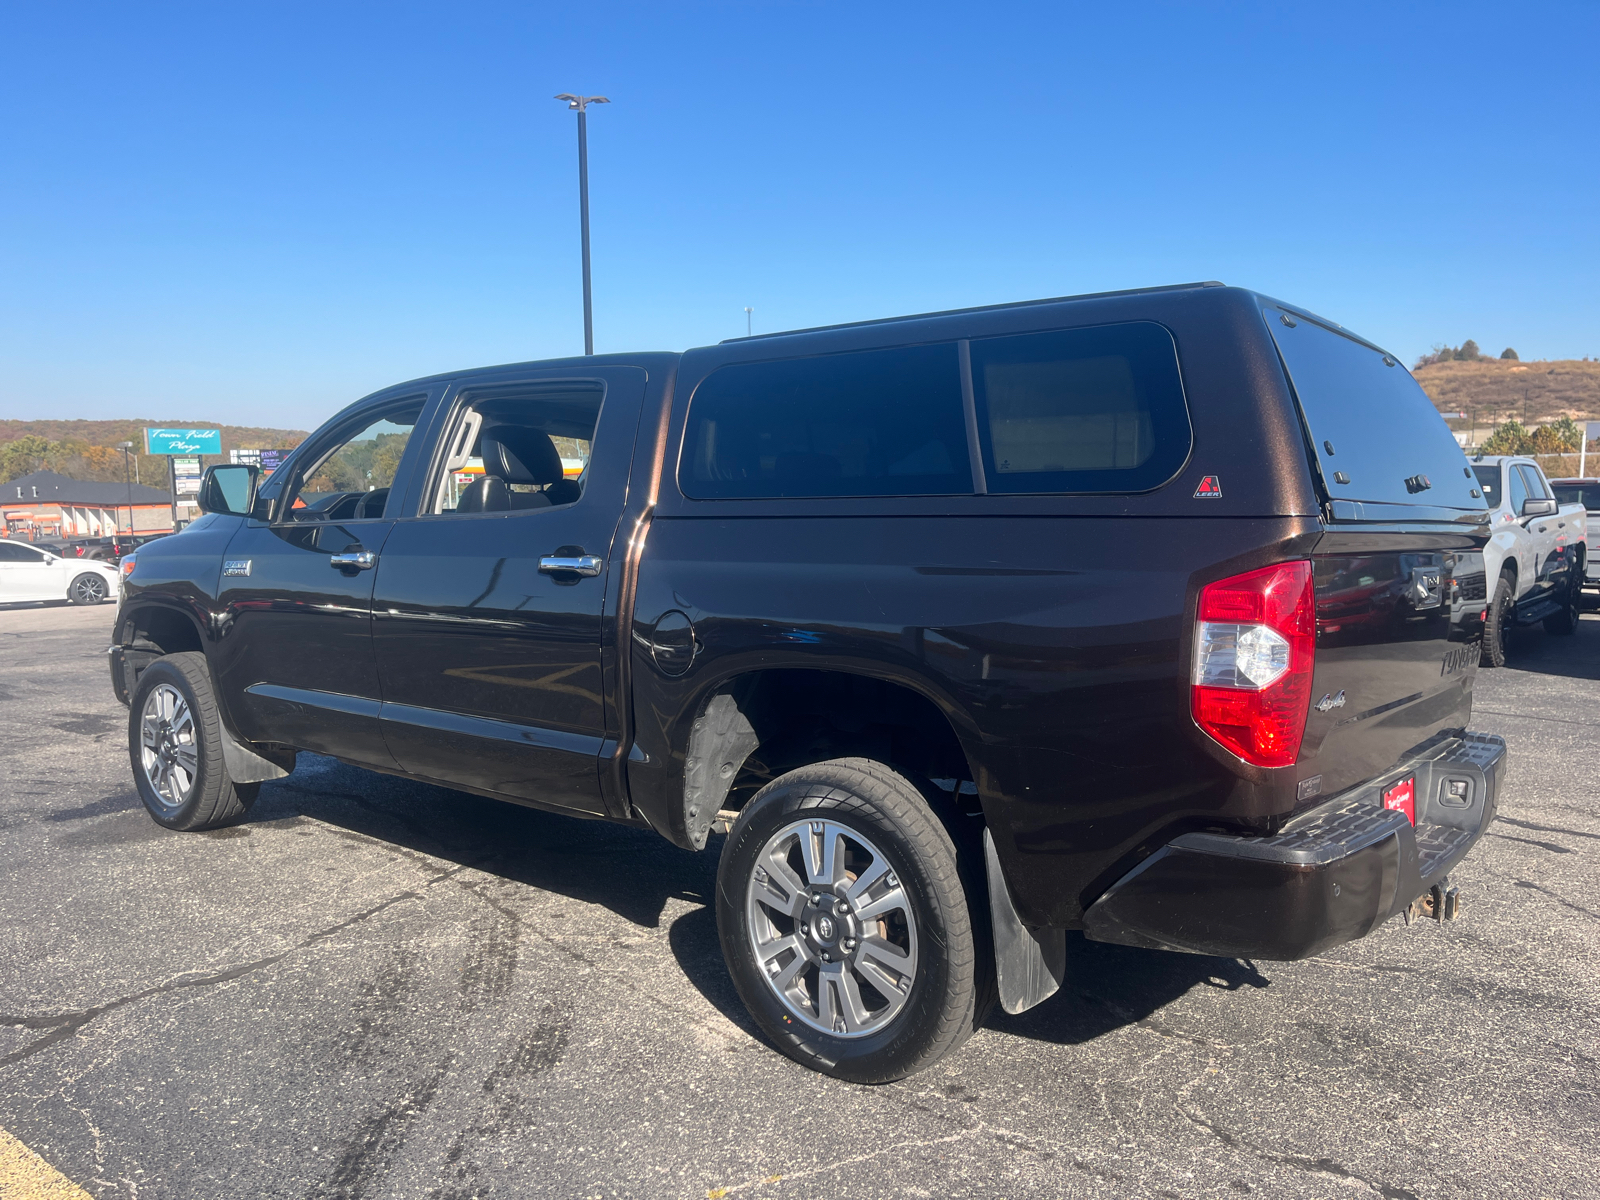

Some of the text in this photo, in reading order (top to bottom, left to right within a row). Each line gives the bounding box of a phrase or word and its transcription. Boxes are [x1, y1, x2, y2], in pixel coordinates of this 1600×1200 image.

[152, 428, 216, 440] Town Field
[169, 440, 201, 453] Plaza
[1441, 640, 1481, 677] TUNDRA
